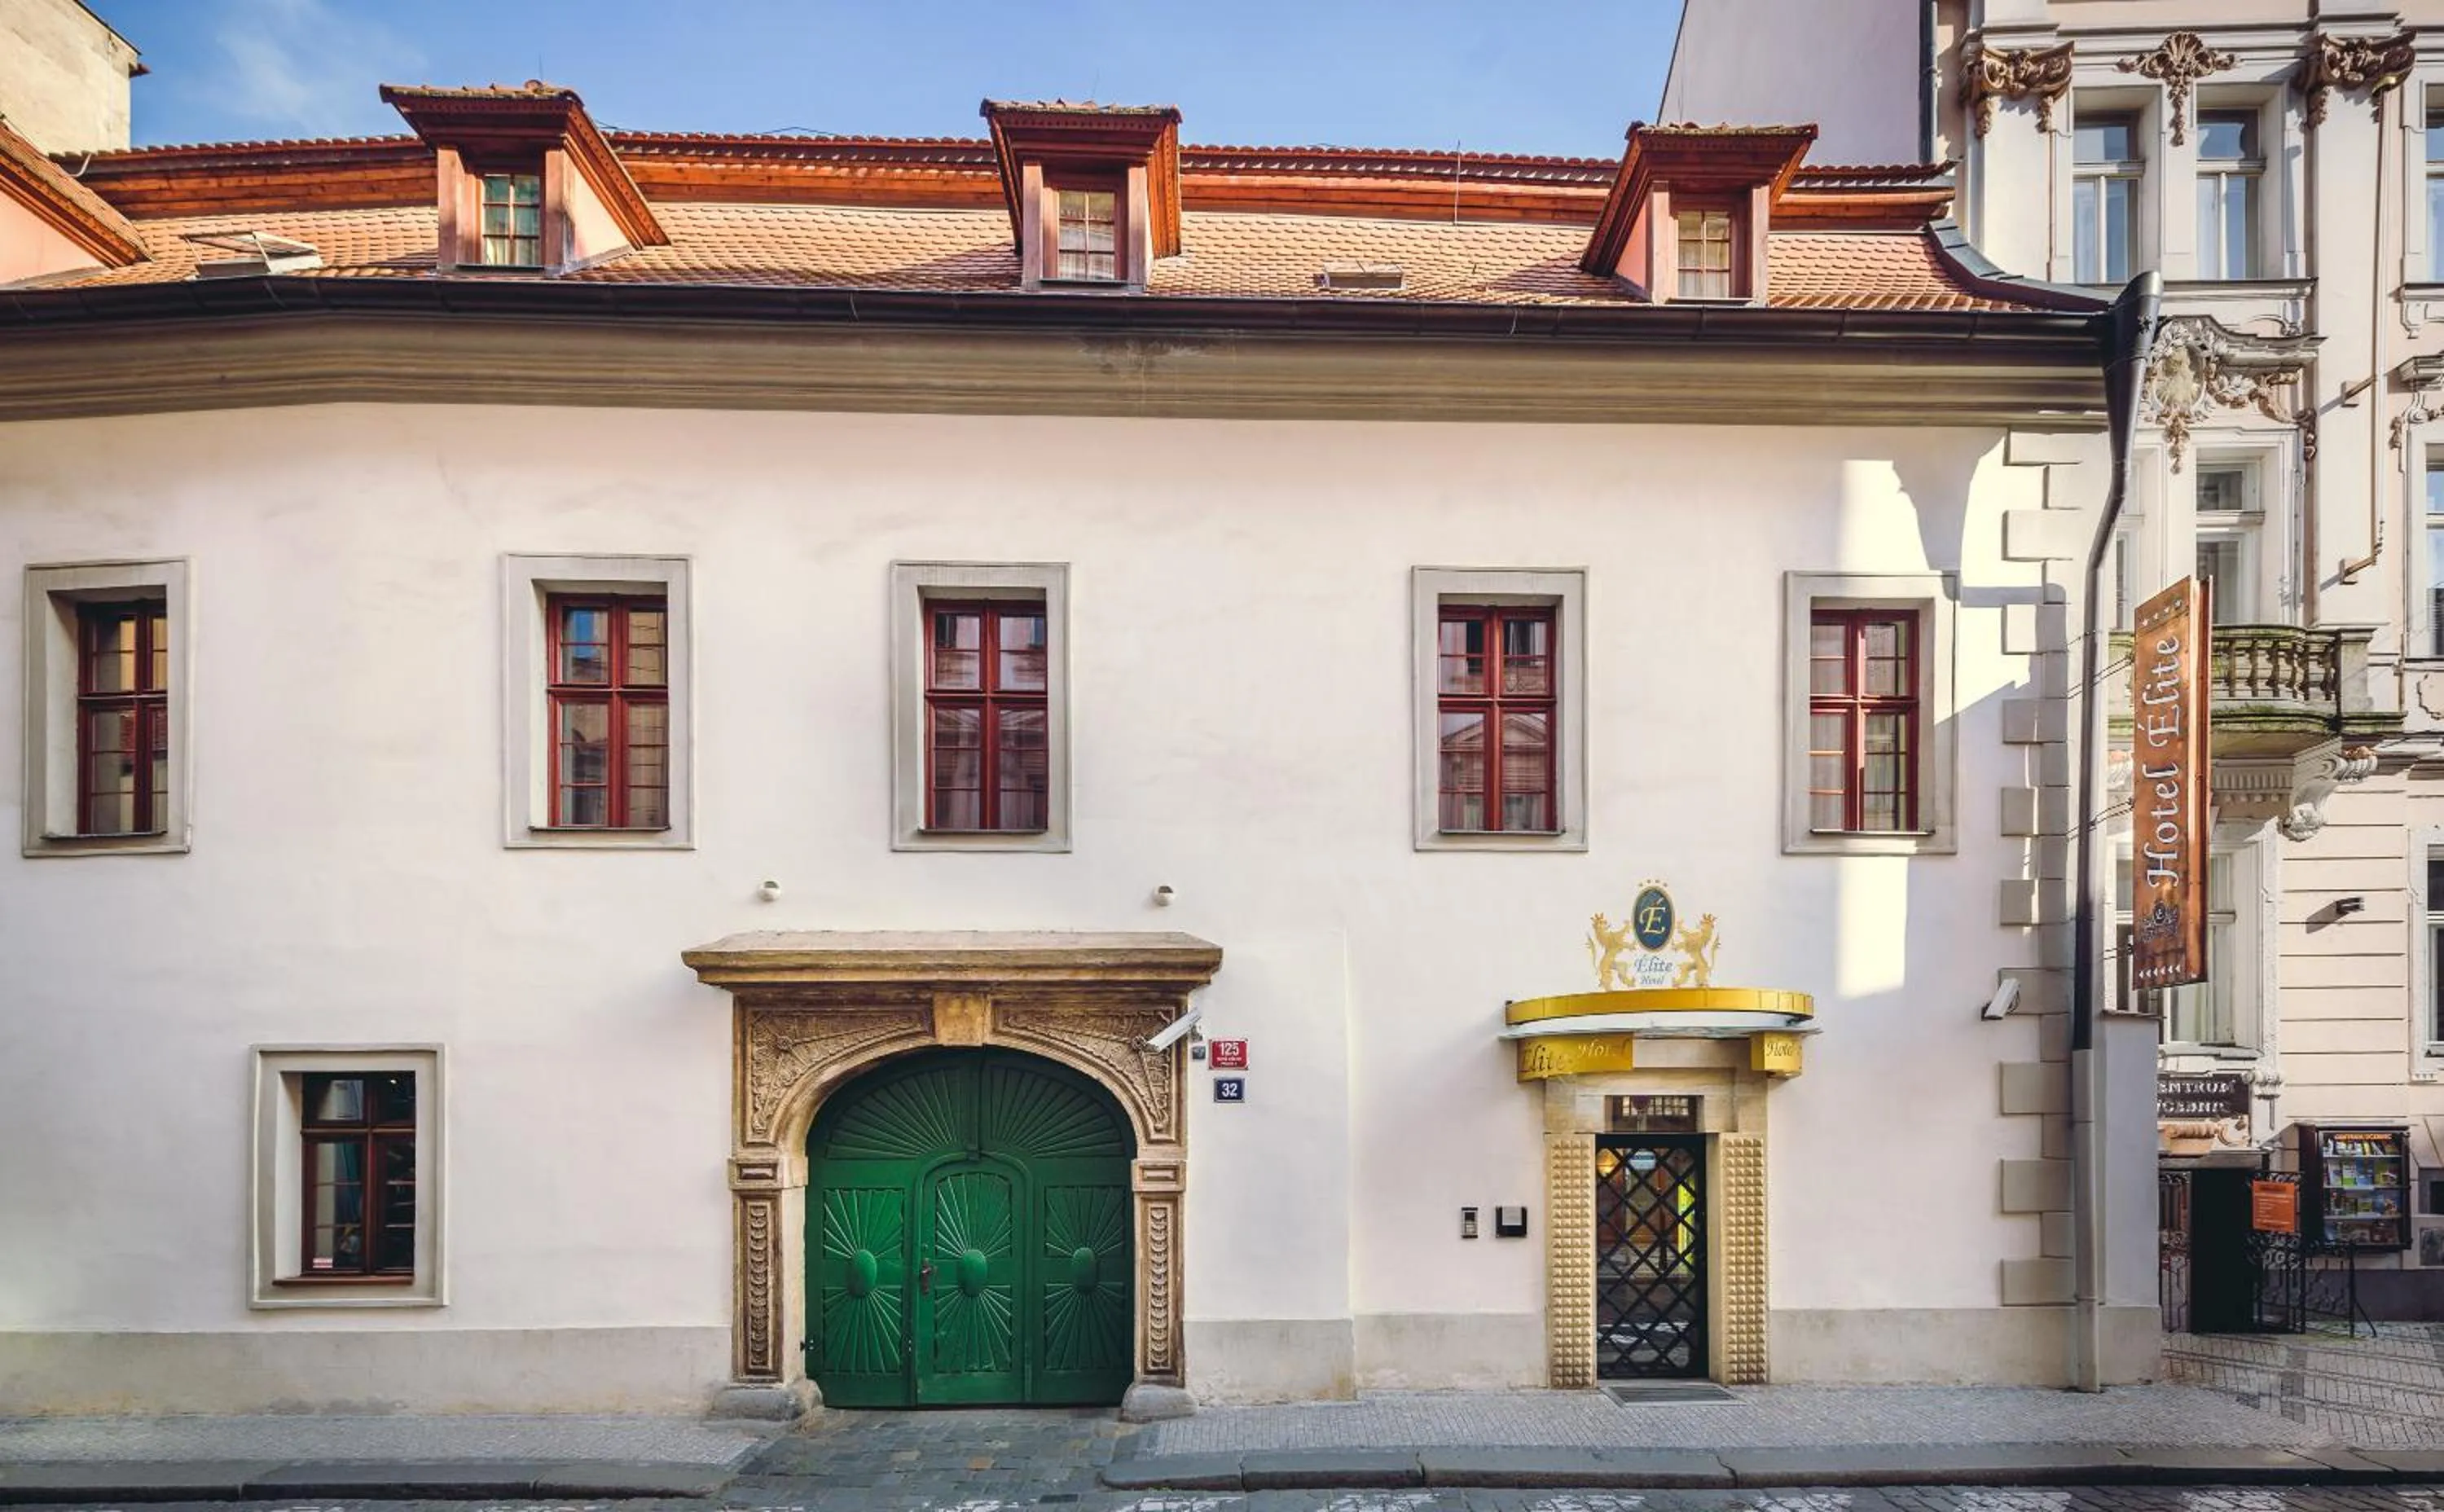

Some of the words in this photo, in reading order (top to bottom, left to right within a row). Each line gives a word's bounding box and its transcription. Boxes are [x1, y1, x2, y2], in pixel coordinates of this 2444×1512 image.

[2137, 635, 2179, 747] Élite
[2142, 762, 2179, 887] Hotel
[1219, 1042, 1240, 1057] 125
[1577, 1039, 1630, 1058] Hotl
[1222, 1083, 1237, 1097] 32
